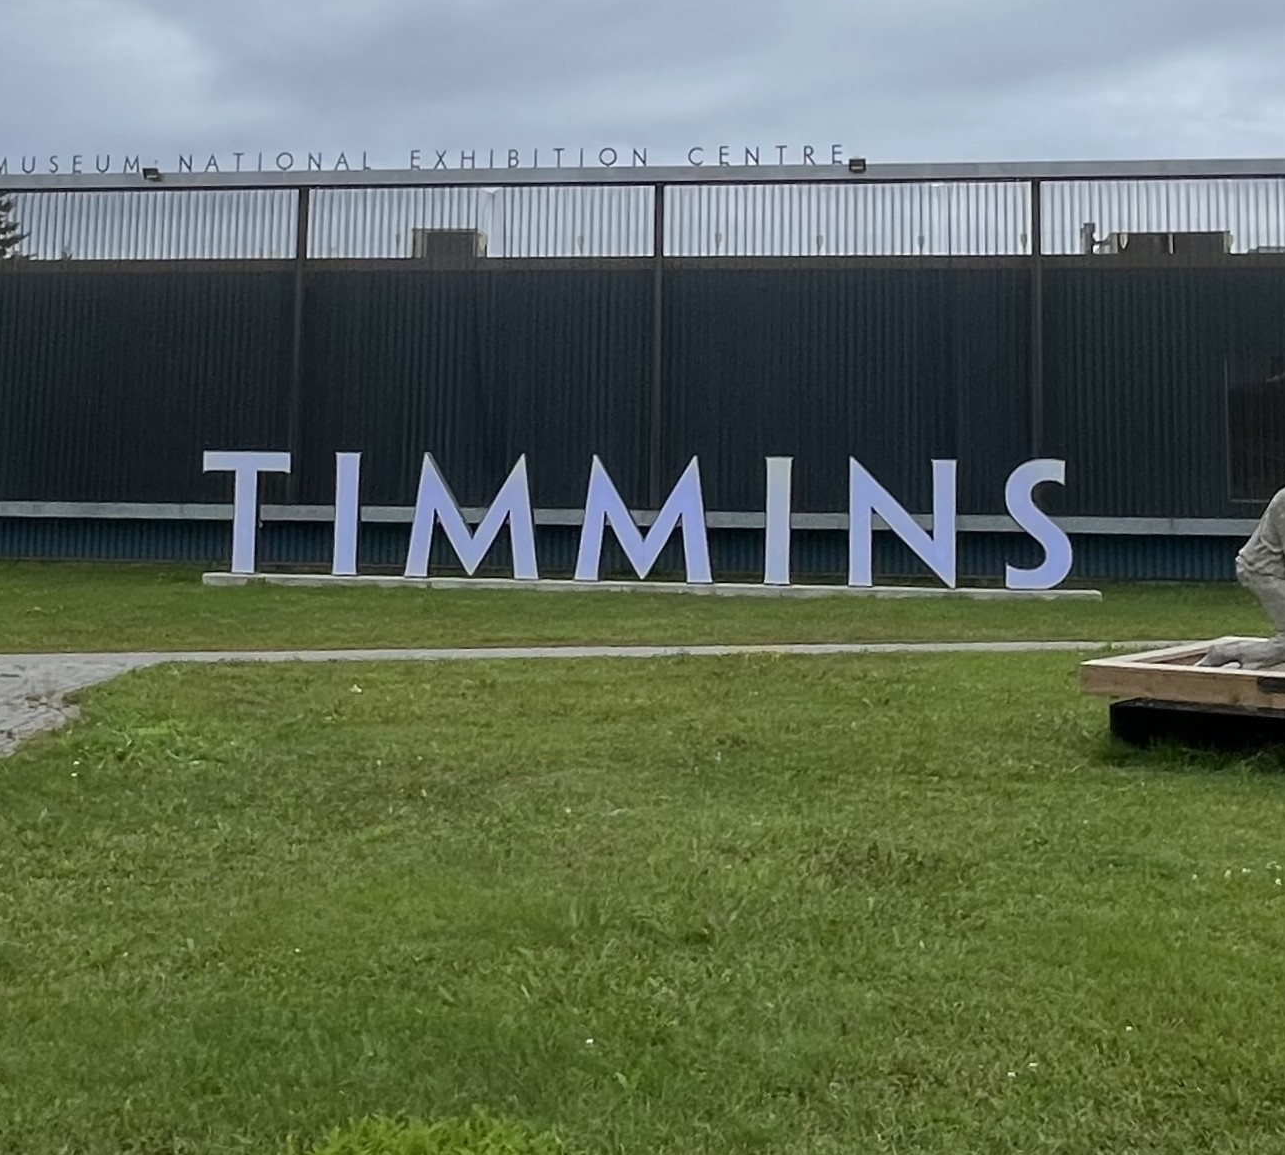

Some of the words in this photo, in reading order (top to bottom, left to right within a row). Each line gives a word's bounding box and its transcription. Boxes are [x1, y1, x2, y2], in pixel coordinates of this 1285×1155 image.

[178, 151, 372, 173] NATIONAL
[410, 147, 648, 170] EXHIBITION
[687, 144, 844, 166] CENTRE
[202, 450, 1074, 590] TIMMINS
